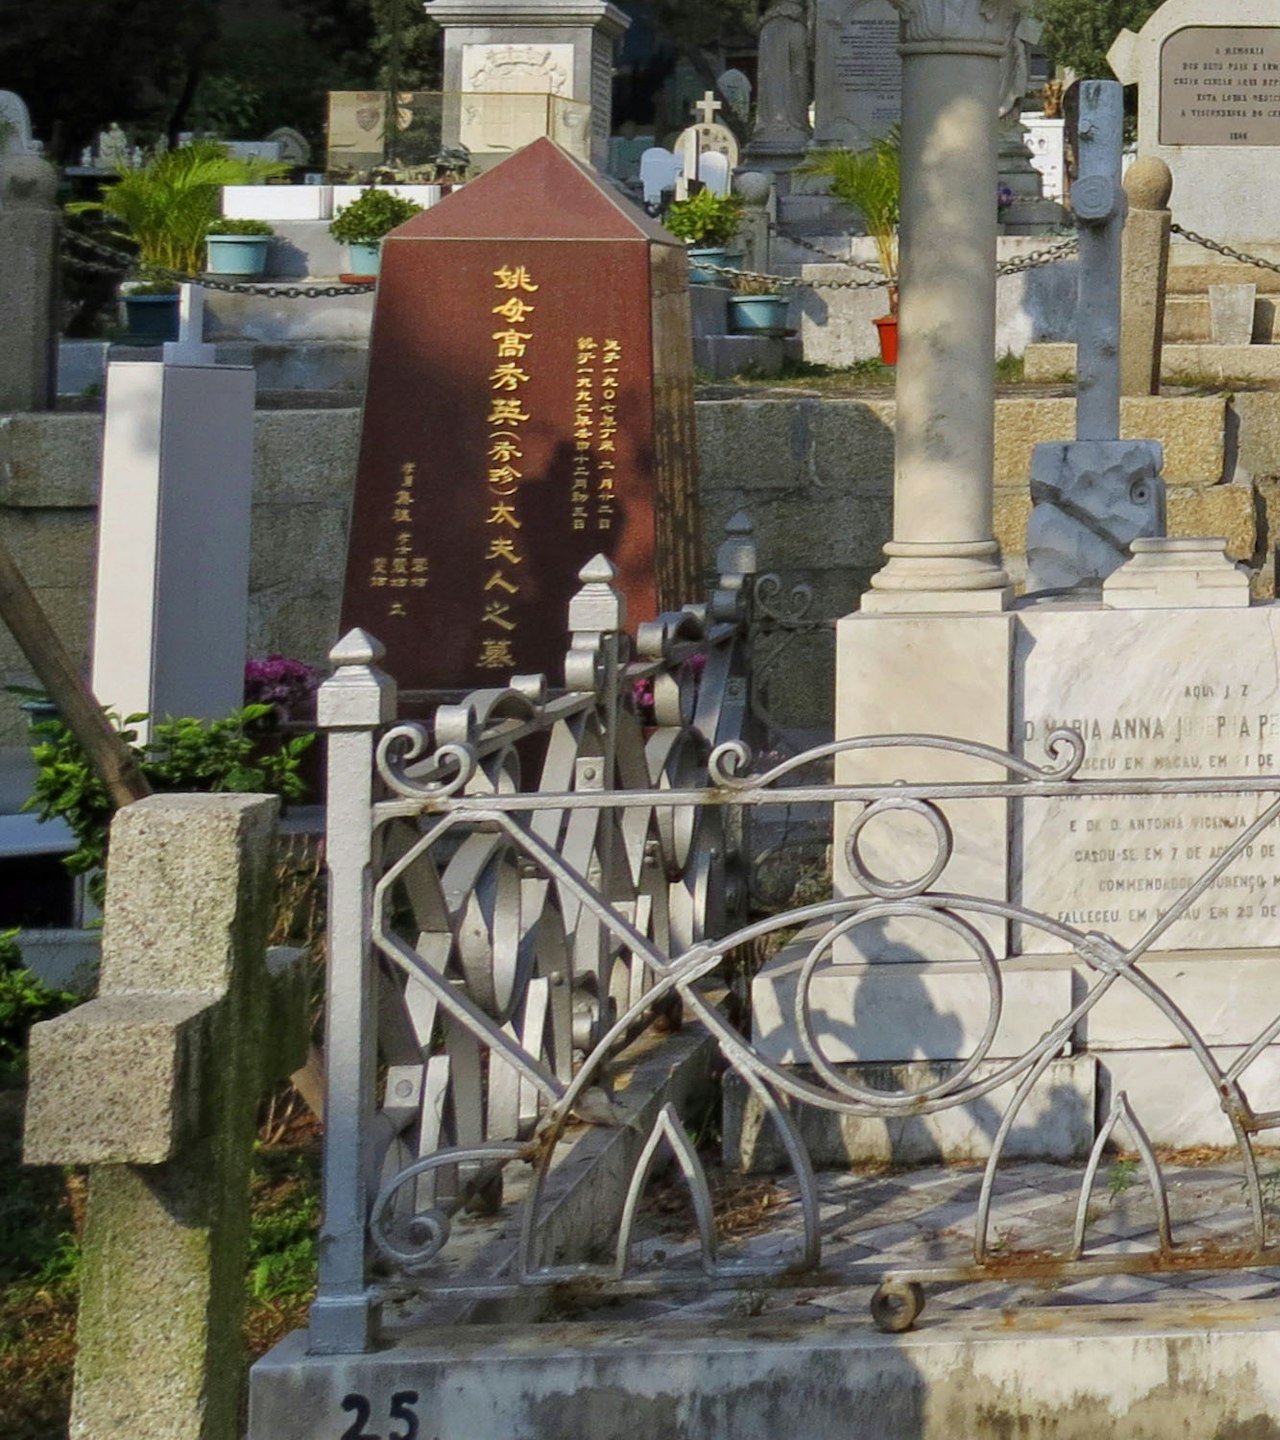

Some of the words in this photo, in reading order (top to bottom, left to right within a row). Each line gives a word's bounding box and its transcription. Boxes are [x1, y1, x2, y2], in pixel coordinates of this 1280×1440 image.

[1111, 716, 1165, 740] ANNA
[1209, 755, 1229, 768] EM
[1257, 753, 1275, 767] DE
[1145, 847, 1163, 861] EM
[1171, 846, 1179, 860] 7
[1186, 845, 1202, 859] DE
[1260, 843, 1276, 858] DE
[1129, 908, 1148, 922] EM
[1261, 903, 1277, 918] DE
[340, 1390, 420, 1440] 25
